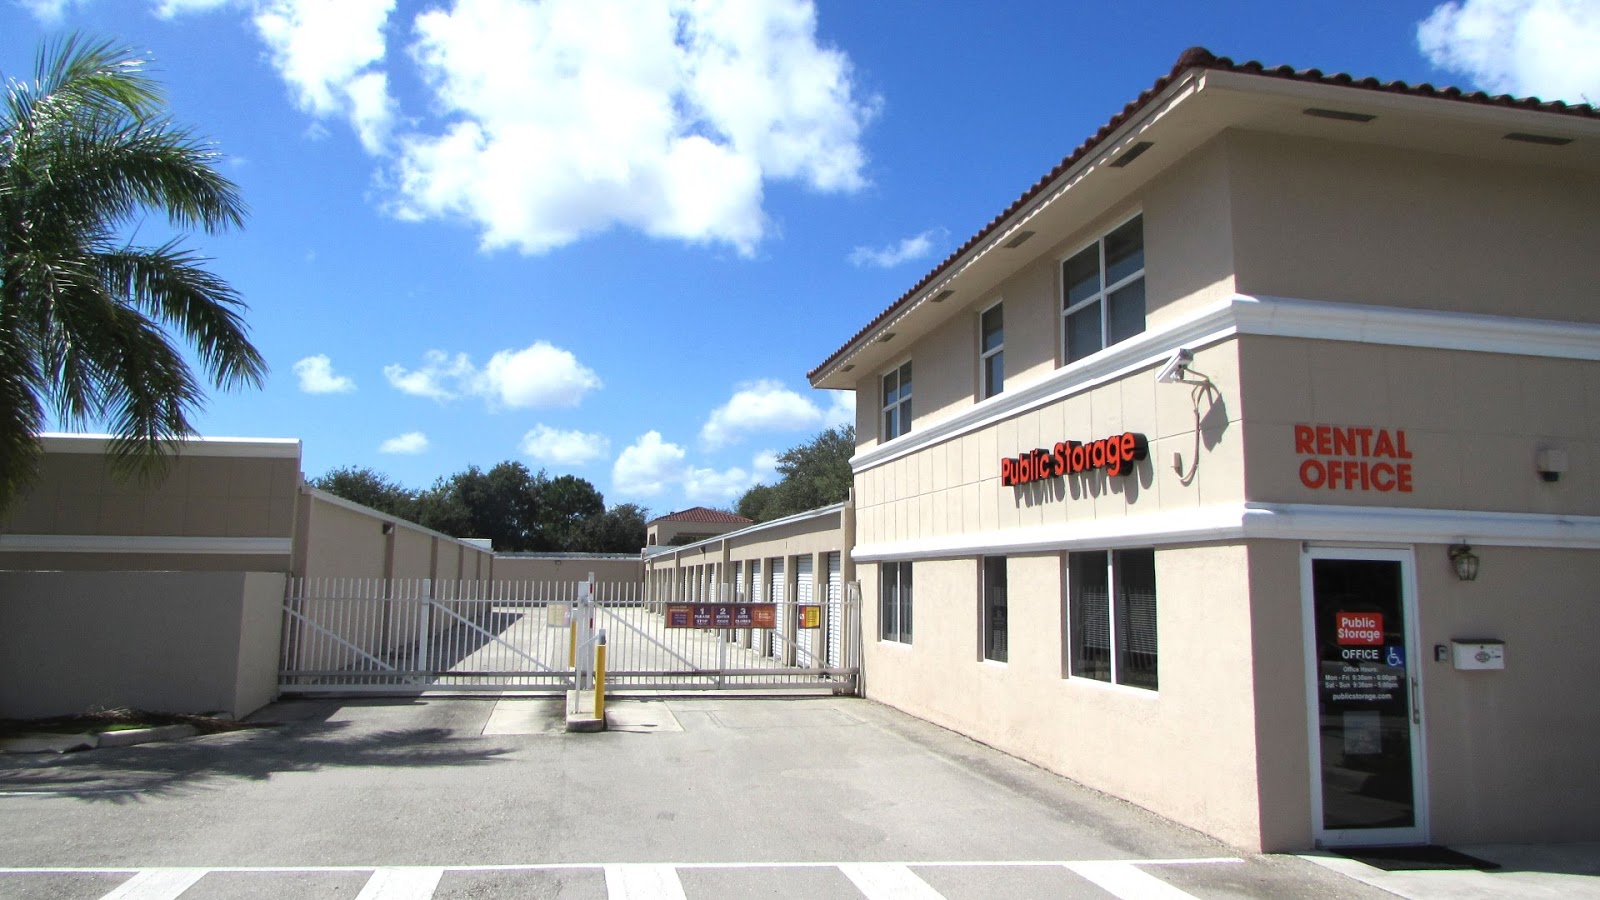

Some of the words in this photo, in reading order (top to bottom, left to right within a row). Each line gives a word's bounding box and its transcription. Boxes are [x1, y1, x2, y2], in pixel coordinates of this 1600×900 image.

[1294, 424, 1413, 459] RENTAL
[1001, 448, 1050, 487] Public
[1053, 431, 1136, 477] Storage
[1299, 458, 1413, 492] OFFICE
[699, 607, 705, 615] 1
[719, 607, 726, 615] 2
[740, 607, 746, 615] 3
[1341, 616, 1376, 628] Public
[1338, 628, 1380, 642] Storage
[1341, 649, 1379, 660] OFFICE
[1332, 693, 1392, 701] publicstorage.com
